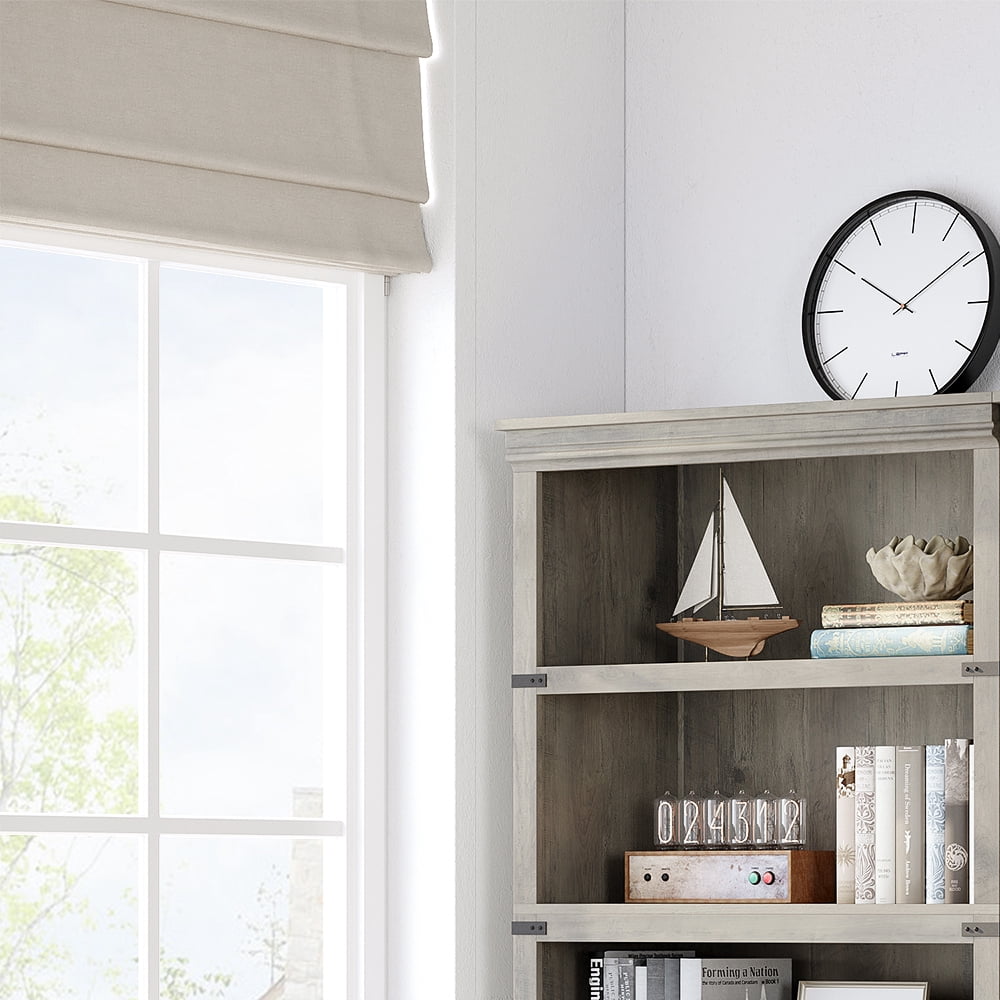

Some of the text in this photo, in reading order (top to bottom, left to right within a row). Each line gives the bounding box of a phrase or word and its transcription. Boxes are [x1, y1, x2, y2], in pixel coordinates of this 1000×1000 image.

[903, 763, 911, 793] Dreaming
[622, 972, 631, 997] PUBLIC
[702, 966, 779, 979] Forming a Nation
